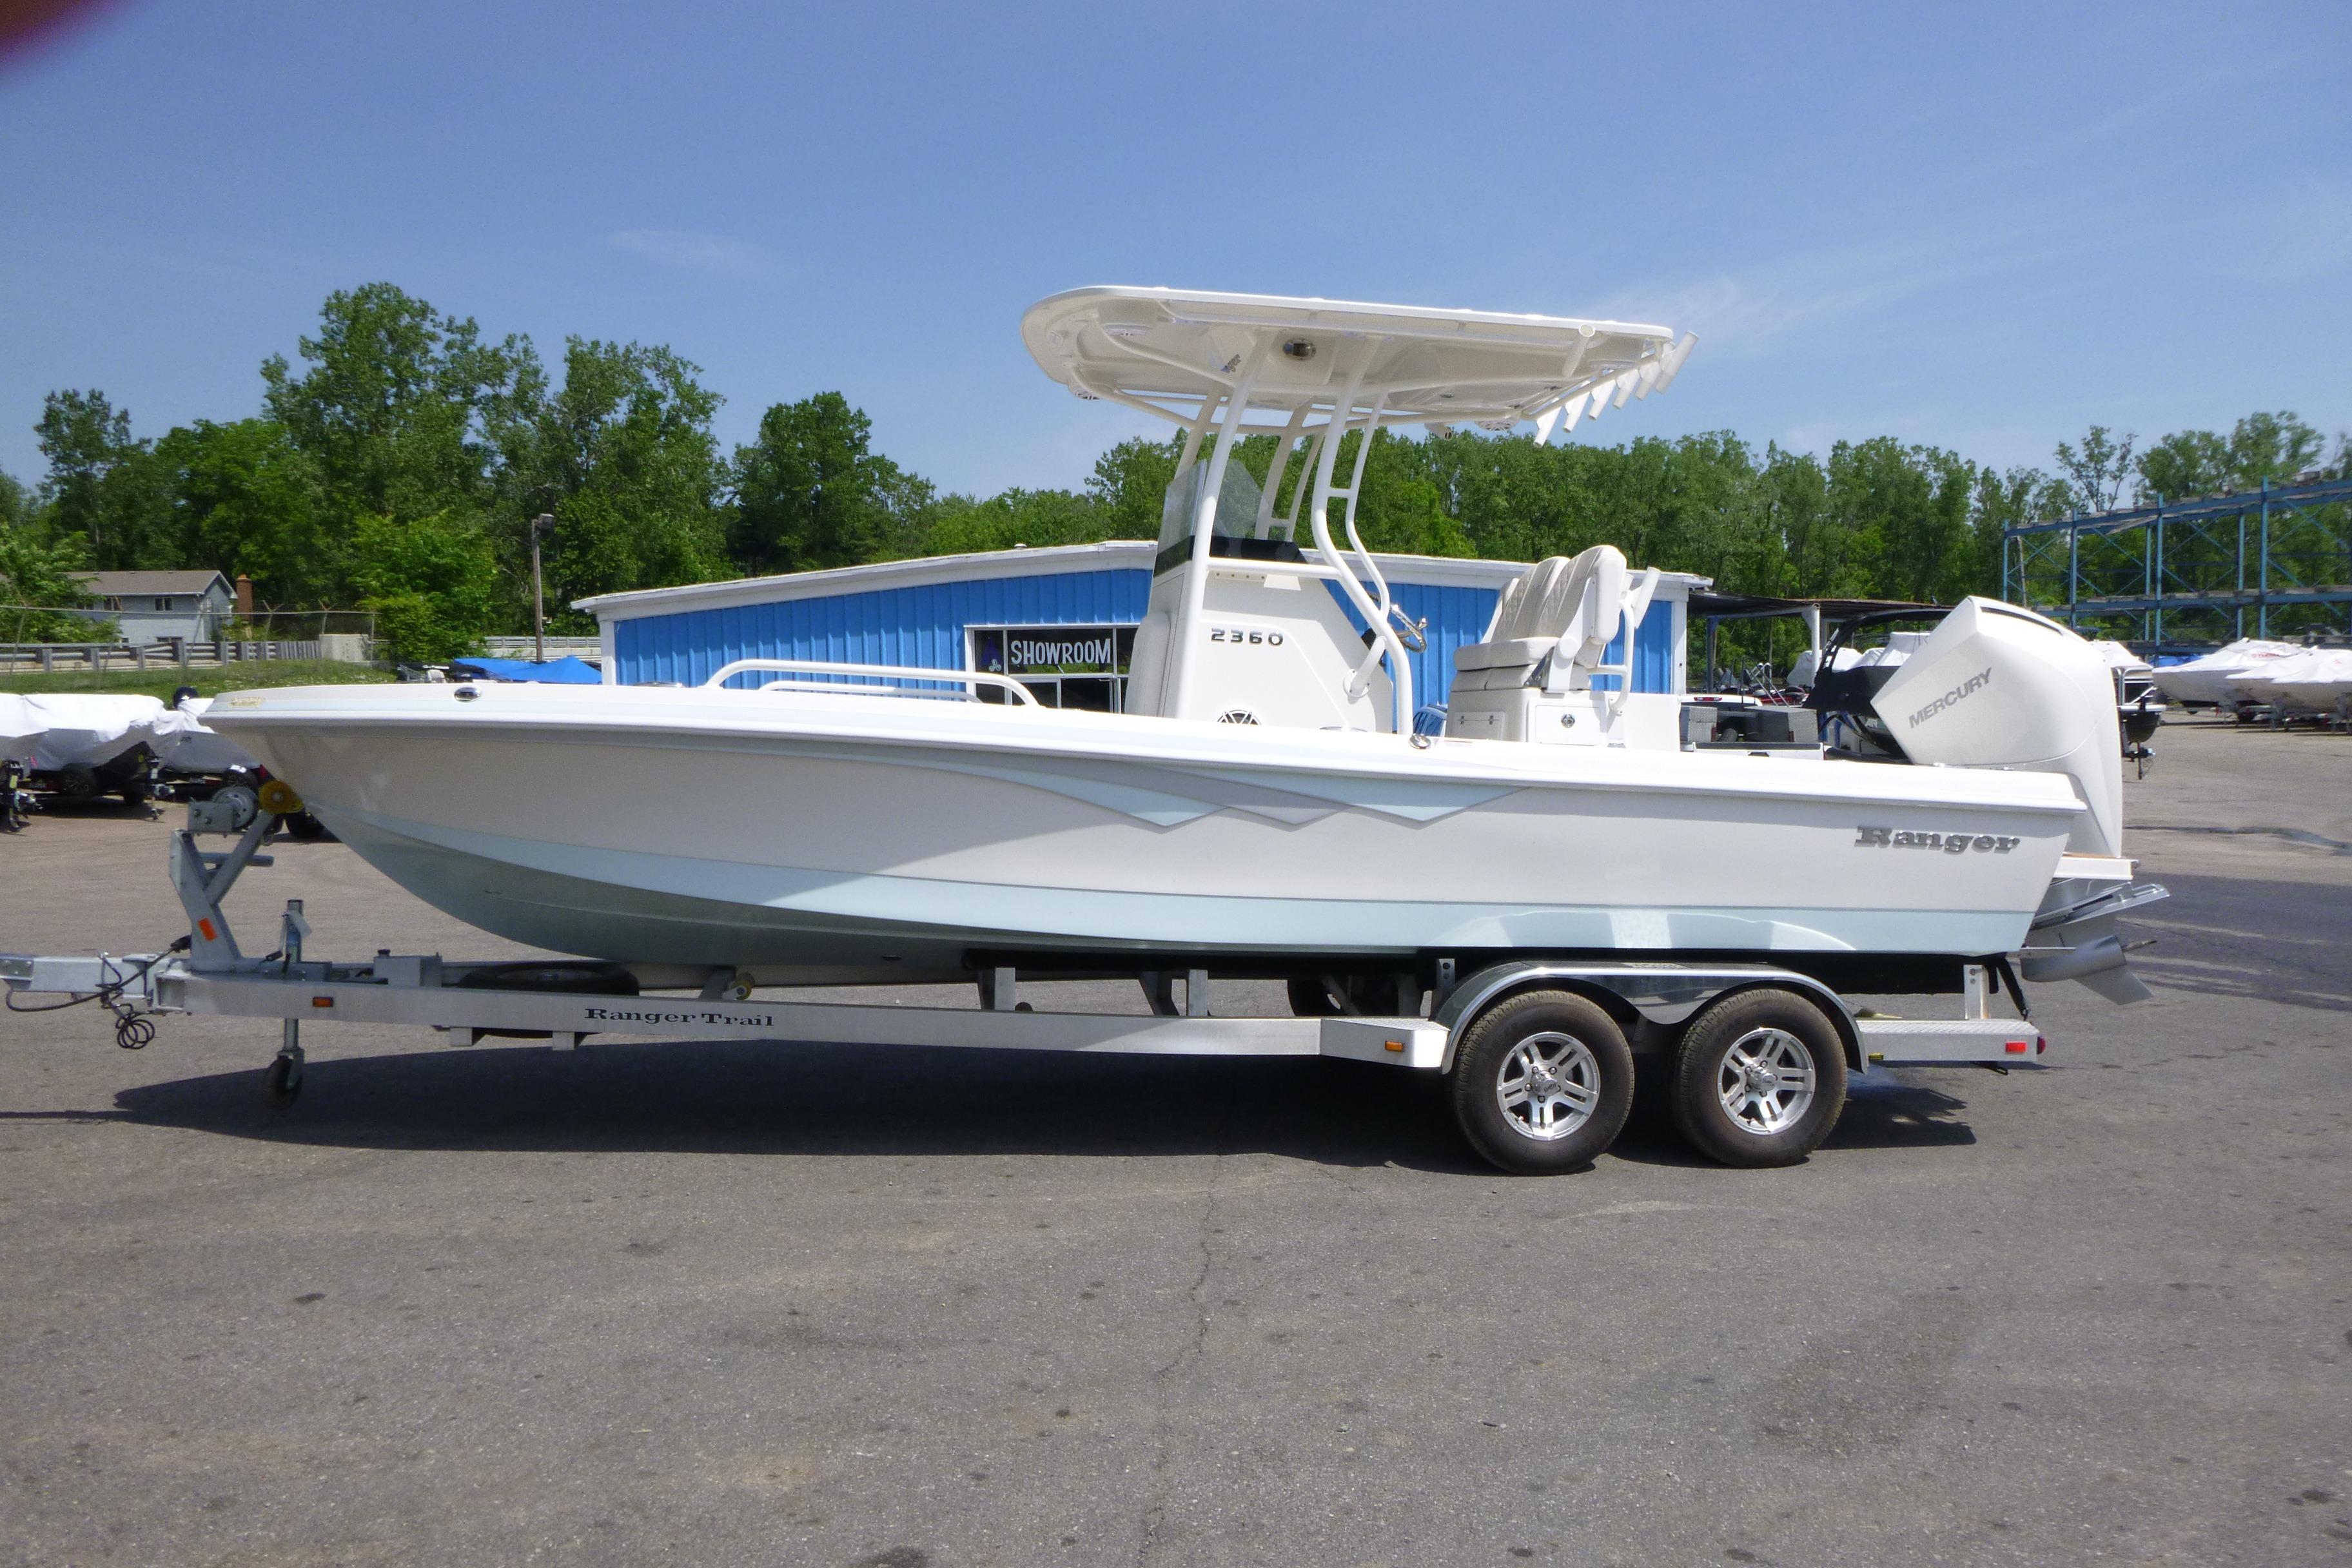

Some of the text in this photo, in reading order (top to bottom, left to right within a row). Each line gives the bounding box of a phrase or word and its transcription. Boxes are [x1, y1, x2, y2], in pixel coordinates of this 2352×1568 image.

[1211, 628, 1284, 646] 2360
[1010, 638, 1111, 665] SHOWROOM
[1908, 667, 1992, 729] MERCURY
[1854, 825, 2021, 855] Ranger
[585, 1008, 774, 1026] Ranger Trail
